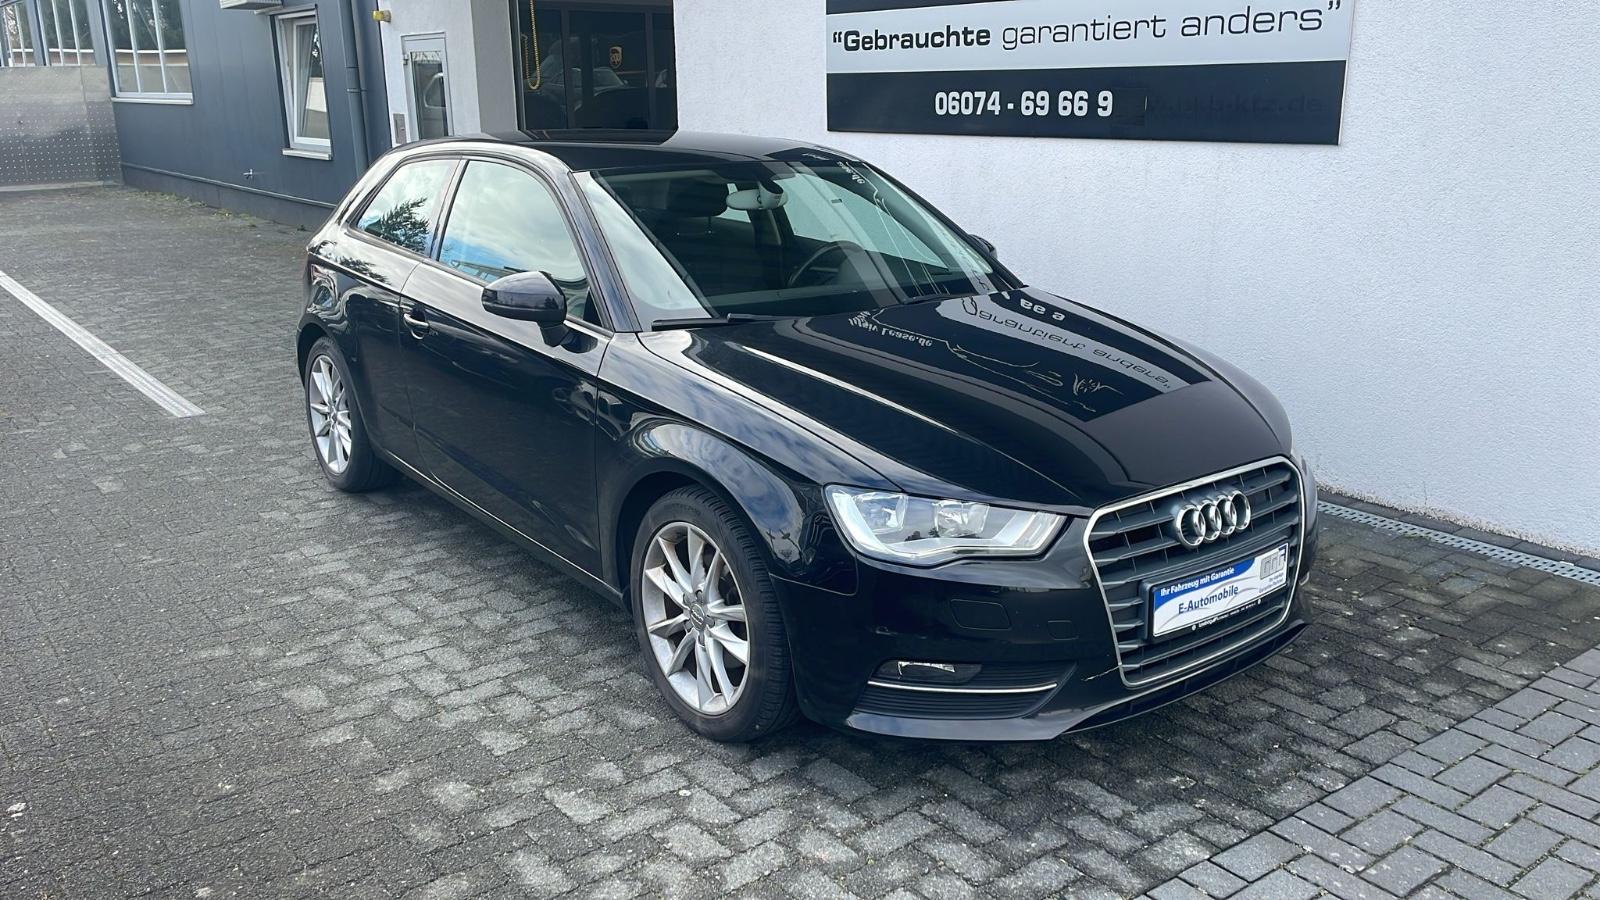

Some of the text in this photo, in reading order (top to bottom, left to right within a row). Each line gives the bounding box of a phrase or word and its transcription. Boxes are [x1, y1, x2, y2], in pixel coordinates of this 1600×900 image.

[1002, 14, 1167, 50] garantiert
[935, 91, 1001, 117] 06074
[1021, 90, 1050, 116] 69
[1058, 90, 1090, 116] 66
[1097, 90, 1113, 116] 9
[1160, 567, 1235, 597] Ihr Fahrzeug mit Garantie
[1178, 584, 1239, 615] E-Automobile
